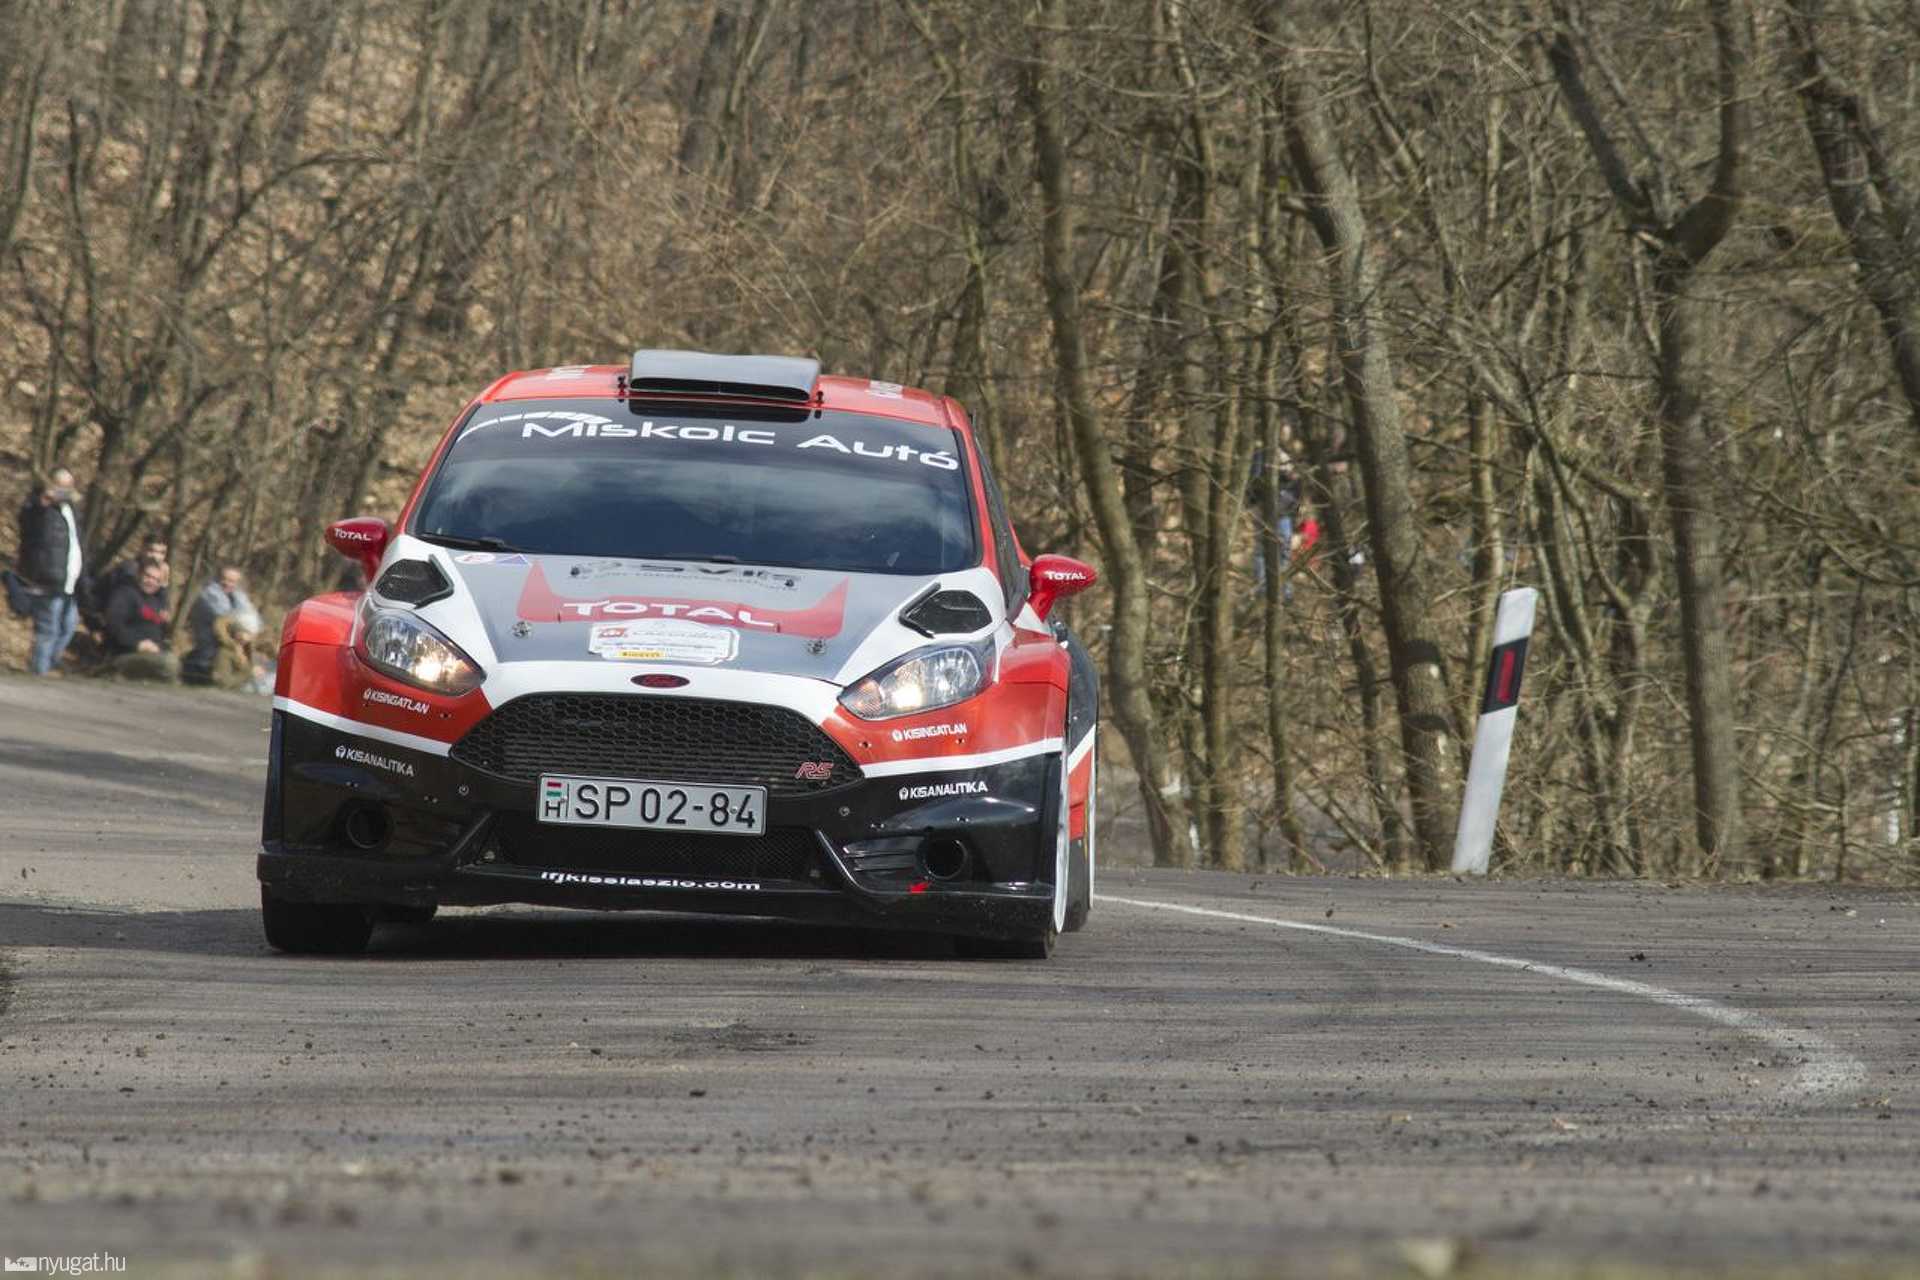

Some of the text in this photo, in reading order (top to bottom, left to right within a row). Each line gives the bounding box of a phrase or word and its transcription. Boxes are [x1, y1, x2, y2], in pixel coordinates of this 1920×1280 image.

[522, 420, 960, 471] Miskolc Autó
[334, 527, 372, 541] TOTAL
[1044, 570, 1087, 581] TOTAL
[563, 600, 775, 628] TOTAL
[903, 722, 968, 740] KISINGATLAN
[346, 748, 415, 777] KISANALITIKA
[795, 761, 835, 780] RS
[910, 780, 989, 800] KISANALITIKA
